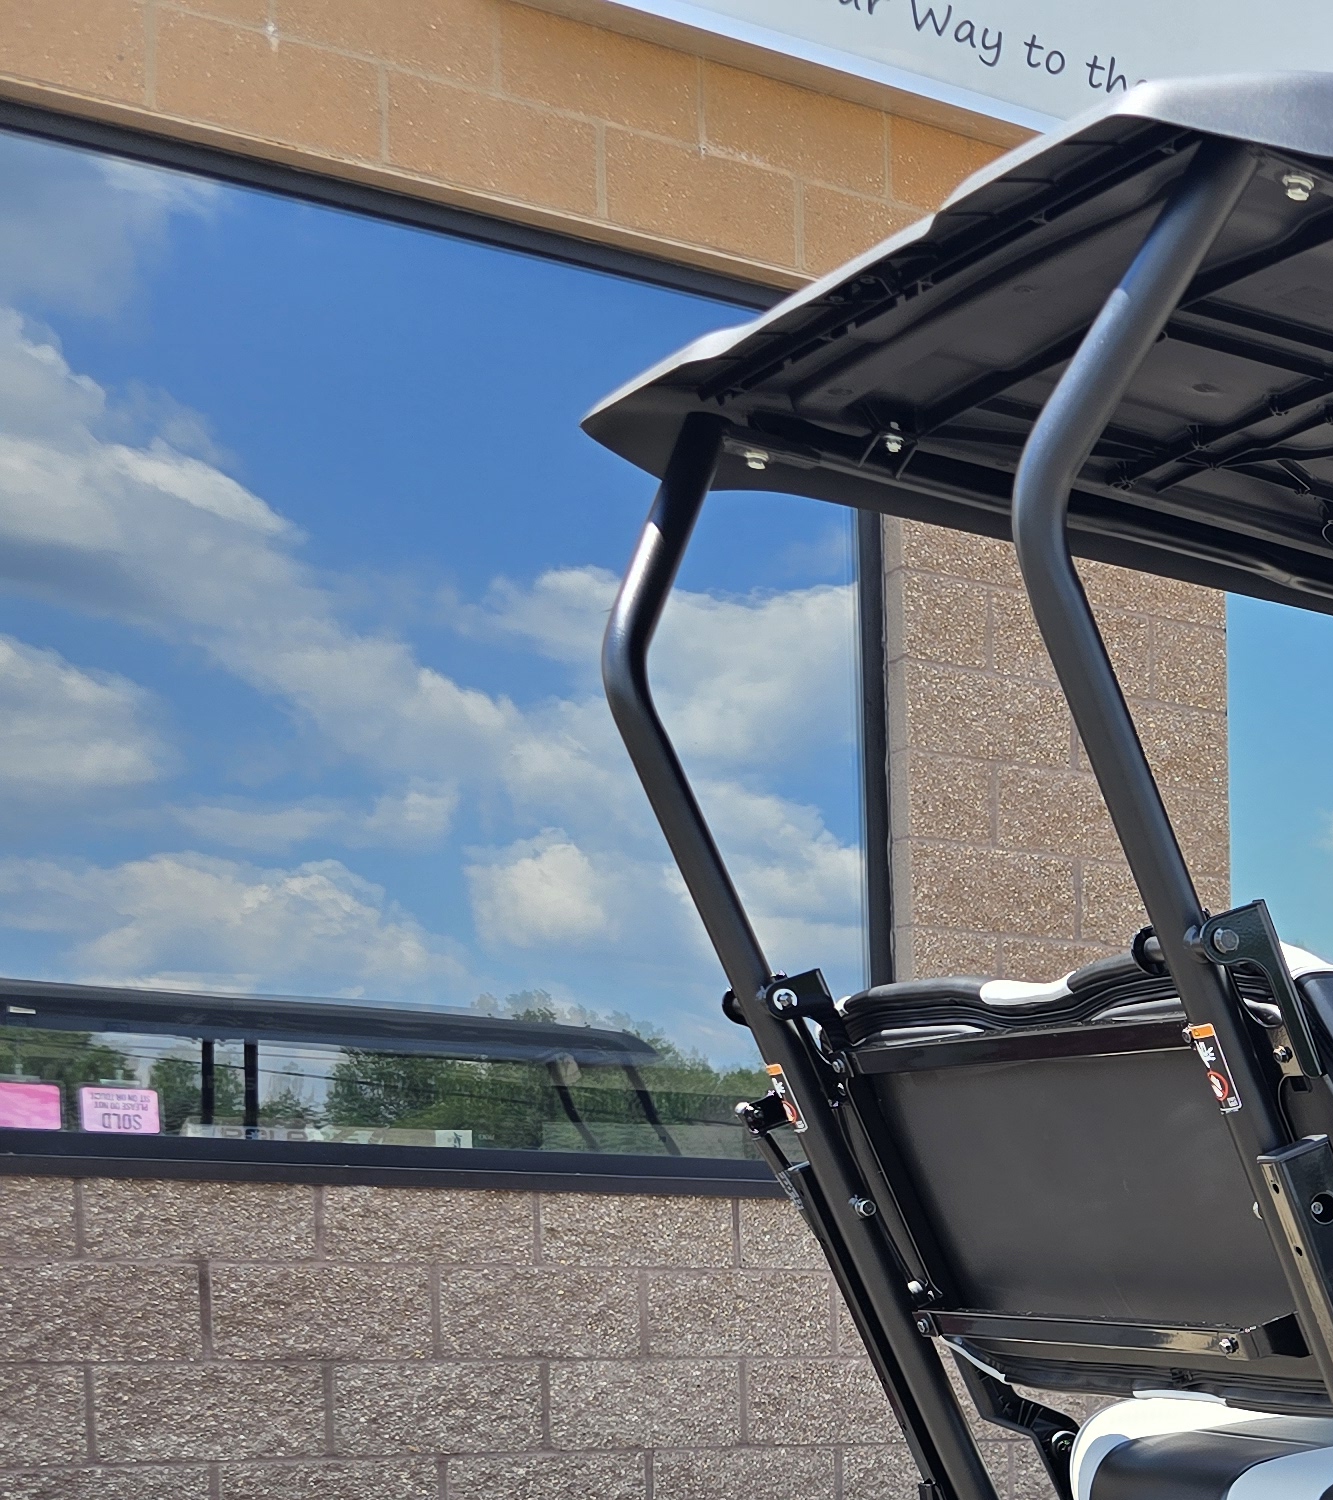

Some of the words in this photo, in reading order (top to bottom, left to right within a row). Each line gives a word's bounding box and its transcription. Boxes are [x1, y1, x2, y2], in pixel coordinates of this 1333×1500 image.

[911, 0, 1003, 68] Way
[1023, 35, 1066, 75] to
[1085, 55, 1148, 93] th
[122, 1102, 148, 1111] PLEASE
[101, 1113, 142, 1130] SOLD
